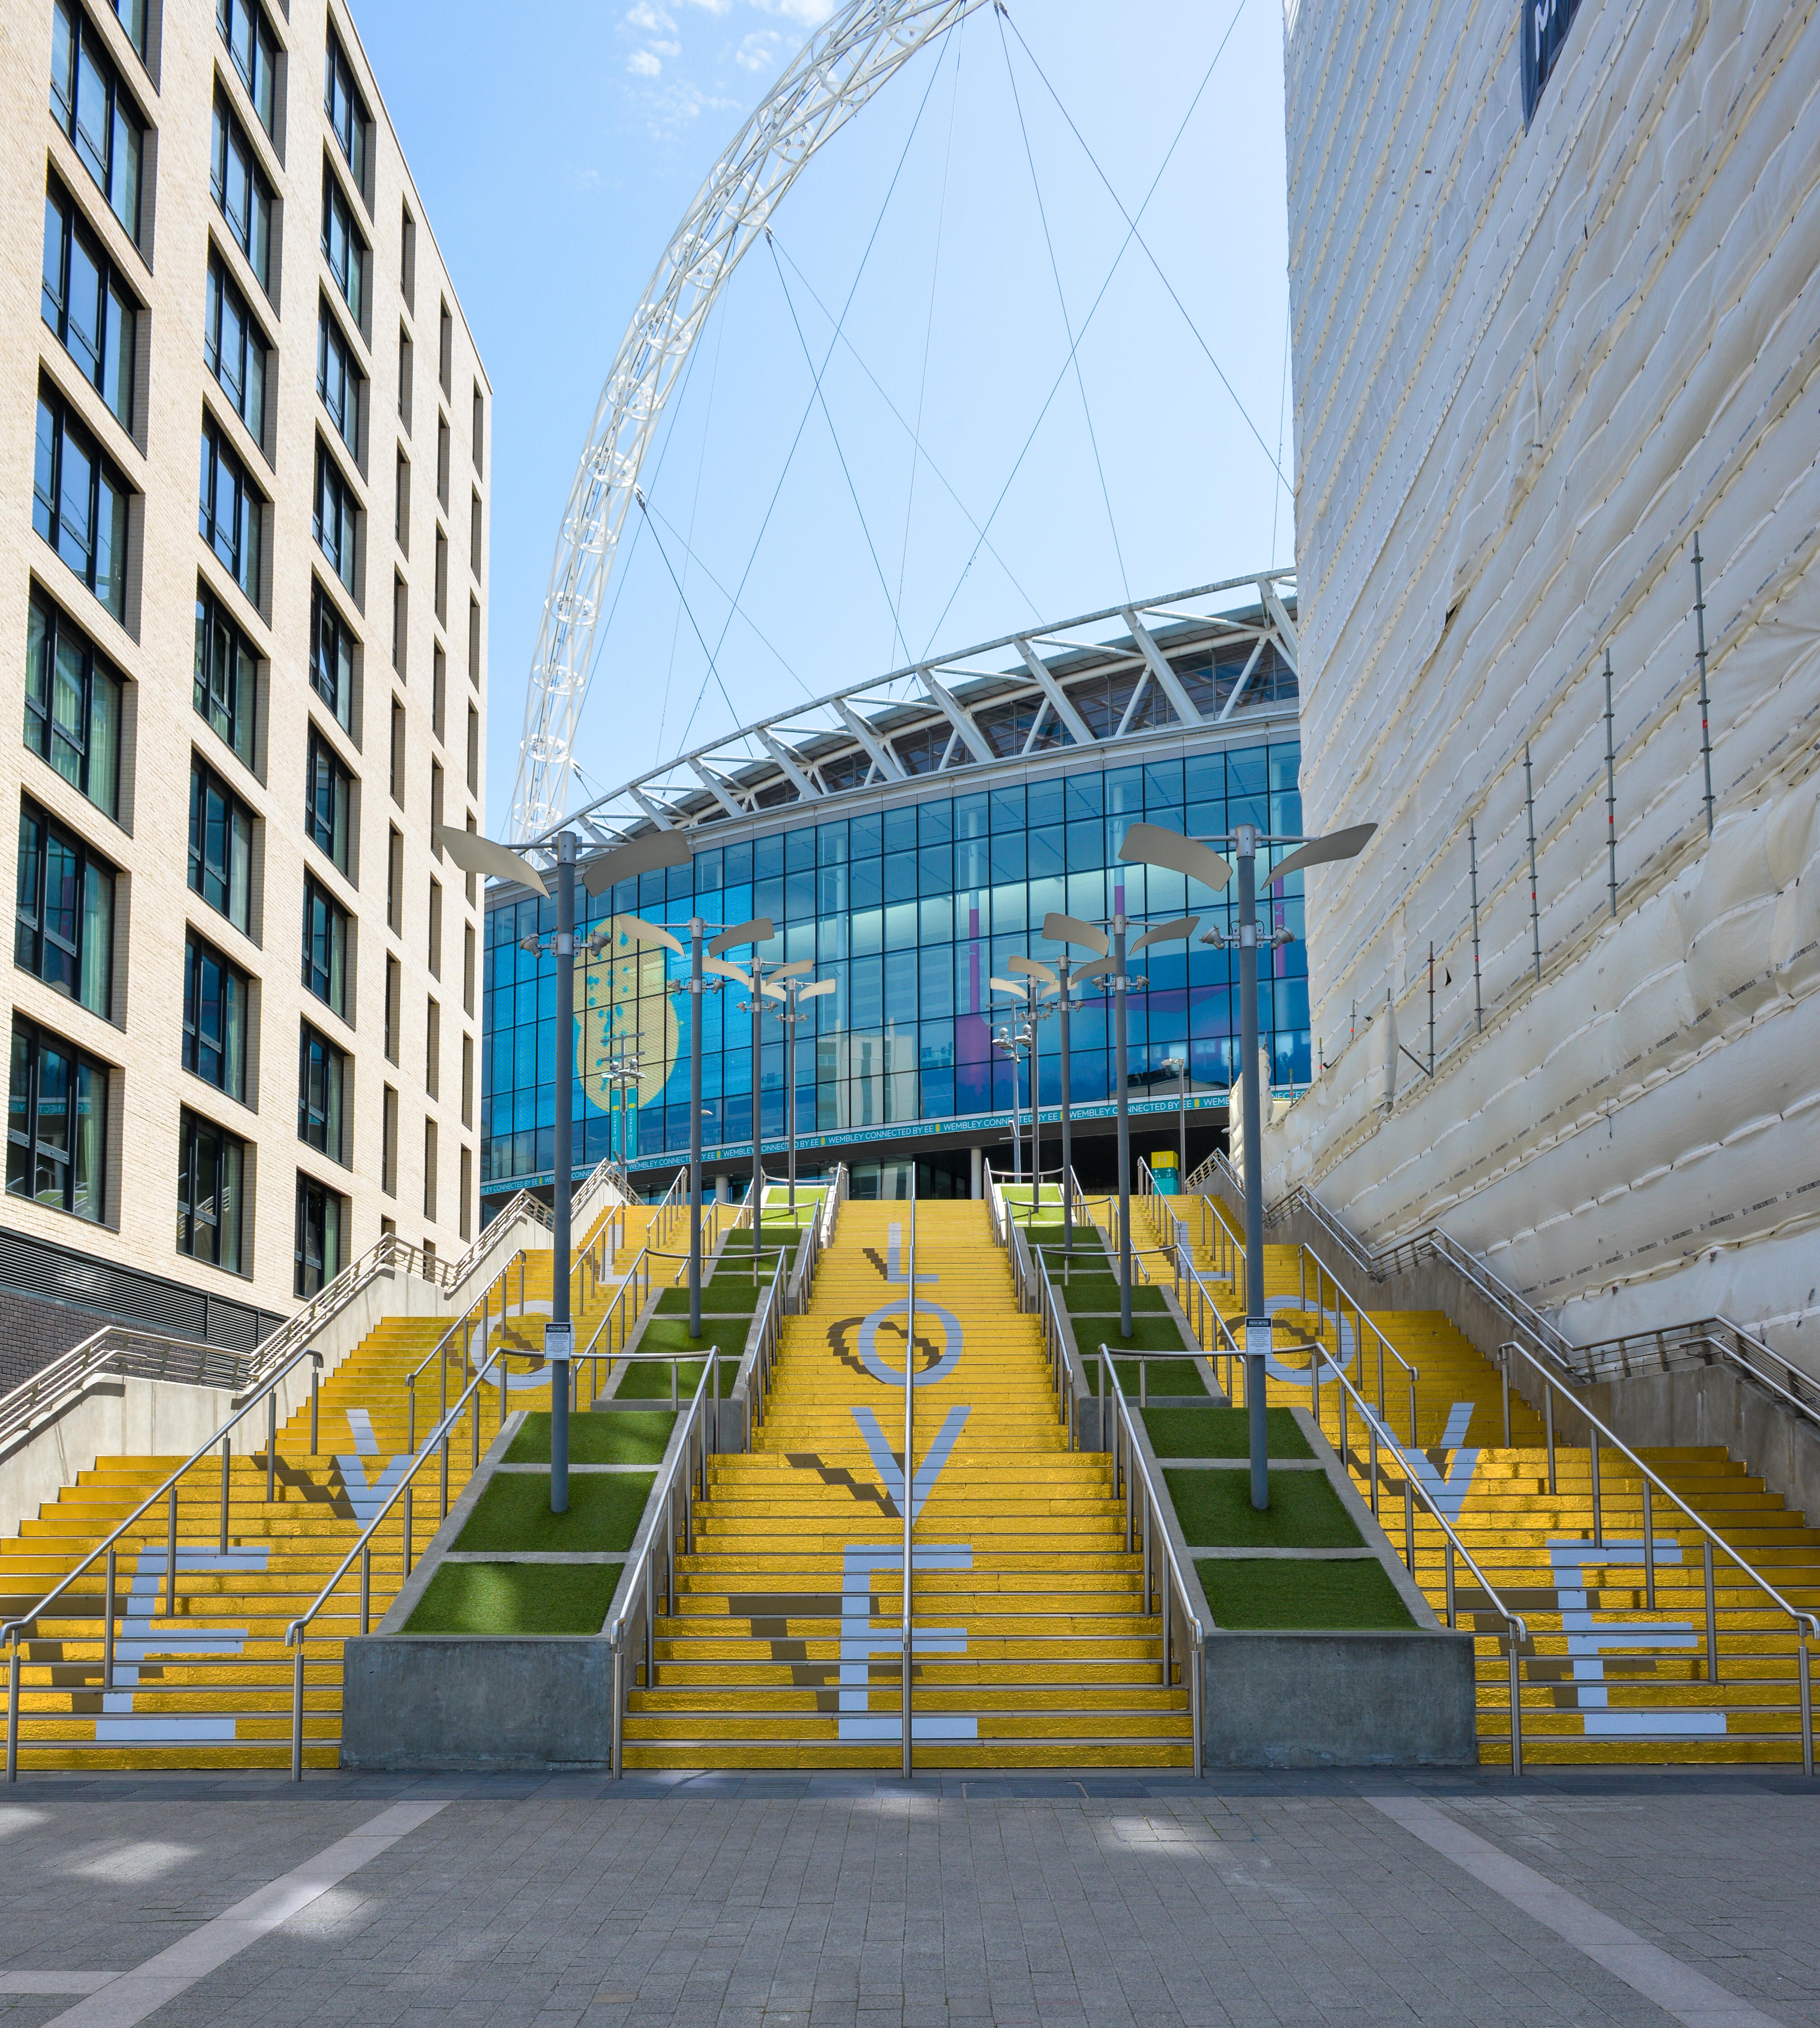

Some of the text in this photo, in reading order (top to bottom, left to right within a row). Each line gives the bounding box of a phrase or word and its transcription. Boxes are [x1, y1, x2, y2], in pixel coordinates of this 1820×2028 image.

[1204, 1097, 1229, 1106] WEMB
[1070, 1108, 1110, 1118] WEMBLEY
[1112, 1102, 1166, 1114] CNNECTED
[1168, 1101, 1180, 1109] BY
[944, 1120, 982, 1131] WEMBLEY
[983, 1115, 1033, 1127] CONNETED
[828, 1133, 864, 1144] WEMBLEY
[865, 1128, 911, 1139] CONNECTED
[913, 1126, 923, 1134] BY
[722, 1147, 754, 1157] WEMBLEY
[761, 1141, 799, 1152] ONNECTD
[629, 1160, 658, 1170] WEMBLEY
[659, 1155, 691, 1166] CONNECTE
[1158, 1153, 1167, 1165] H
[571, 1169, 595, 1178] CONNEC
[493, 1181, 523, 1191] CONNECTED
[838, 1222, 978, 1739] LOVE
